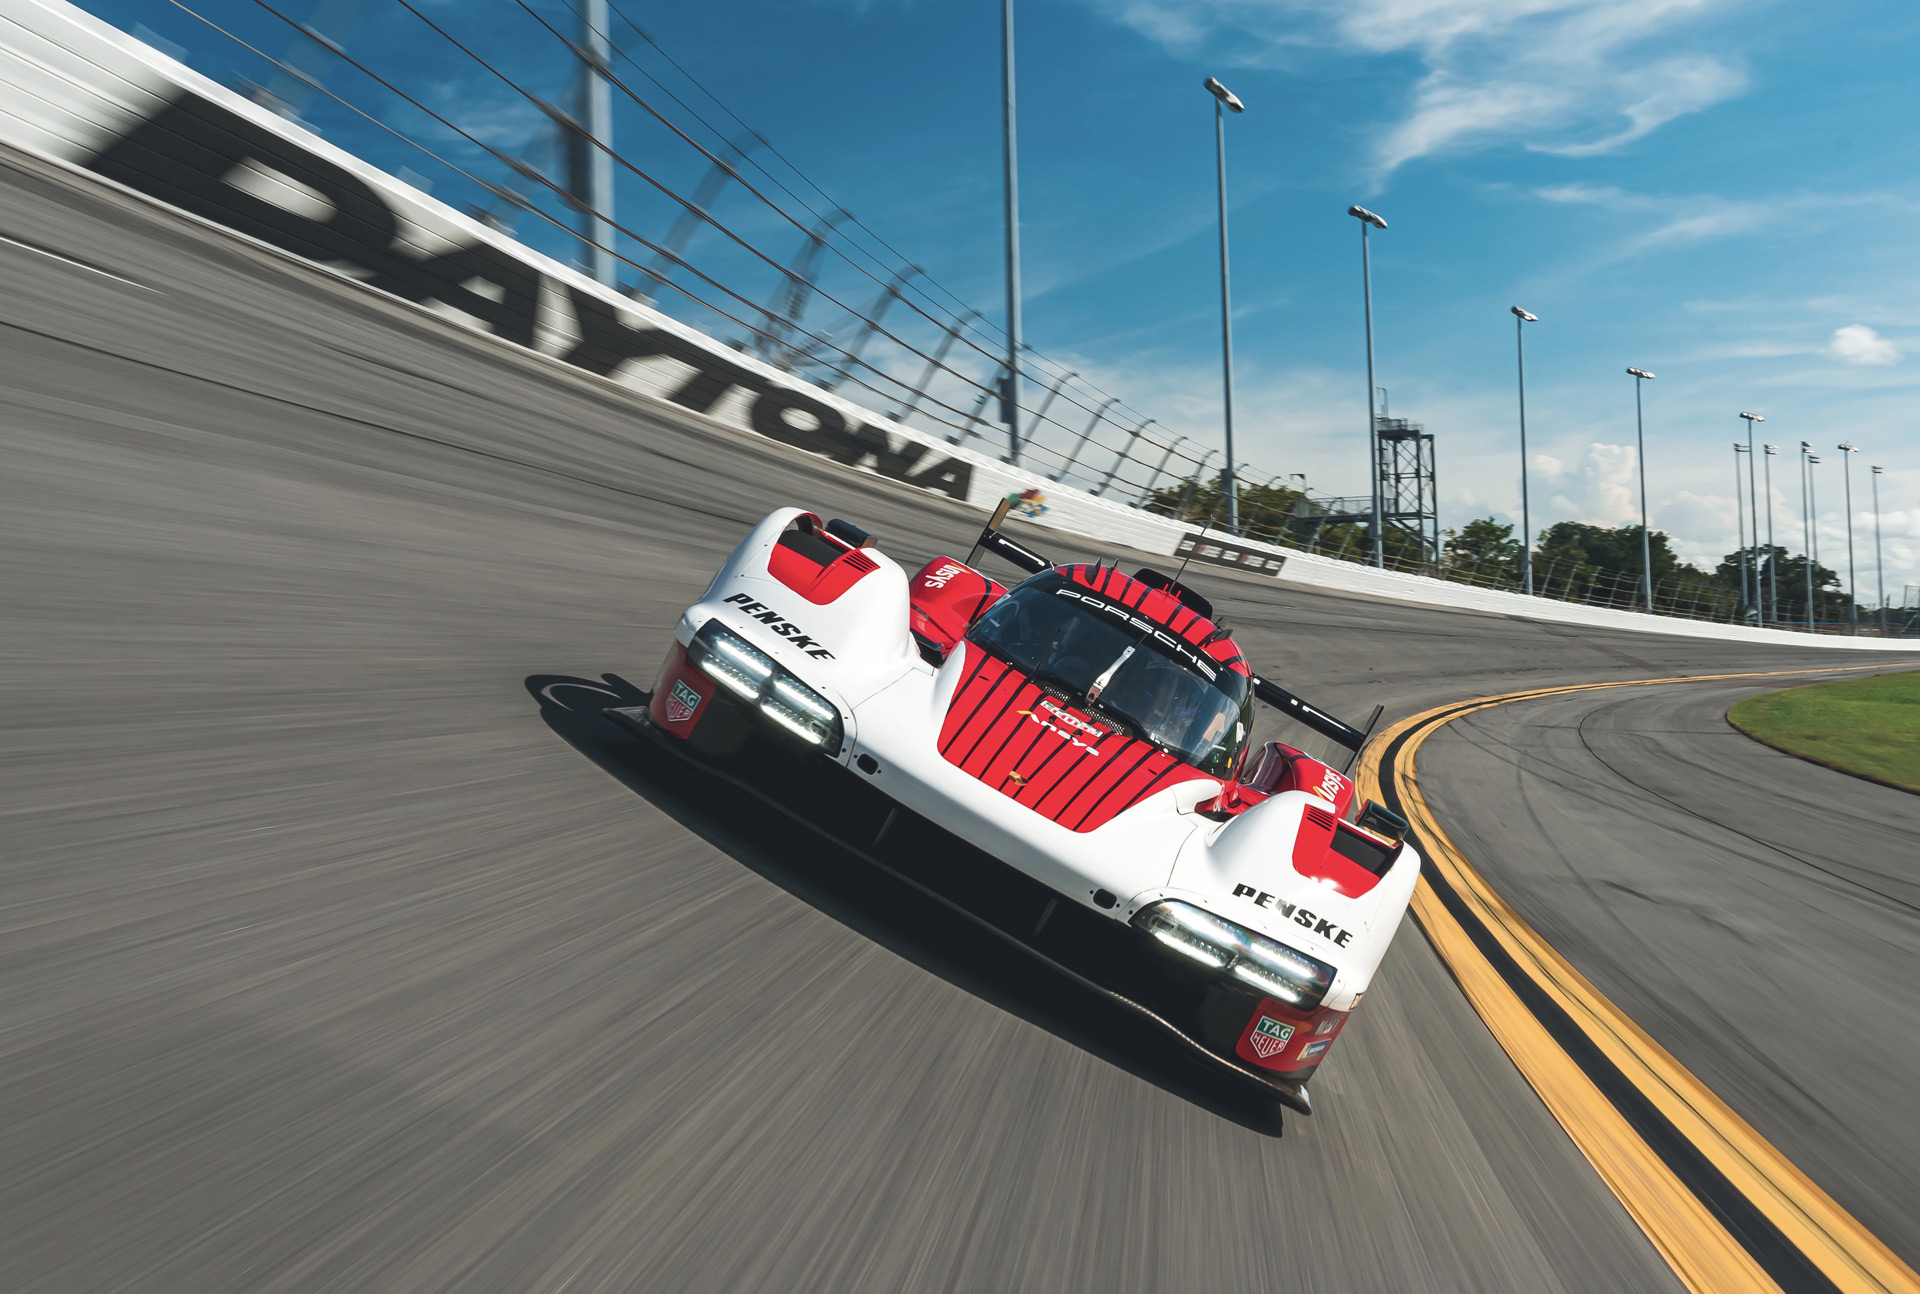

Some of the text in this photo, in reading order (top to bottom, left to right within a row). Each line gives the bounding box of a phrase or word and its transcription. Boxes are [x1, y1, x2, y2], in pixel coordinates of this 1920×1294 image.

[79, 88, 974, 502] DAYTONA
[924, 561, 972, 589] Ansys
[723, 593, 836, 661] PENSKE
[1055, 588, 1217, 682] PORSCHE
[675, 683, 698, 707] TAG
[1016, 710, 1100, 757] Ansys
[1312, 768, 1345, 803] Ansys
[1232, 883, 1353, 948] PENSKE
[1253, 1032, 1284, 1055] HEUER
[1263, 1020, 1291, 1039] TAG
